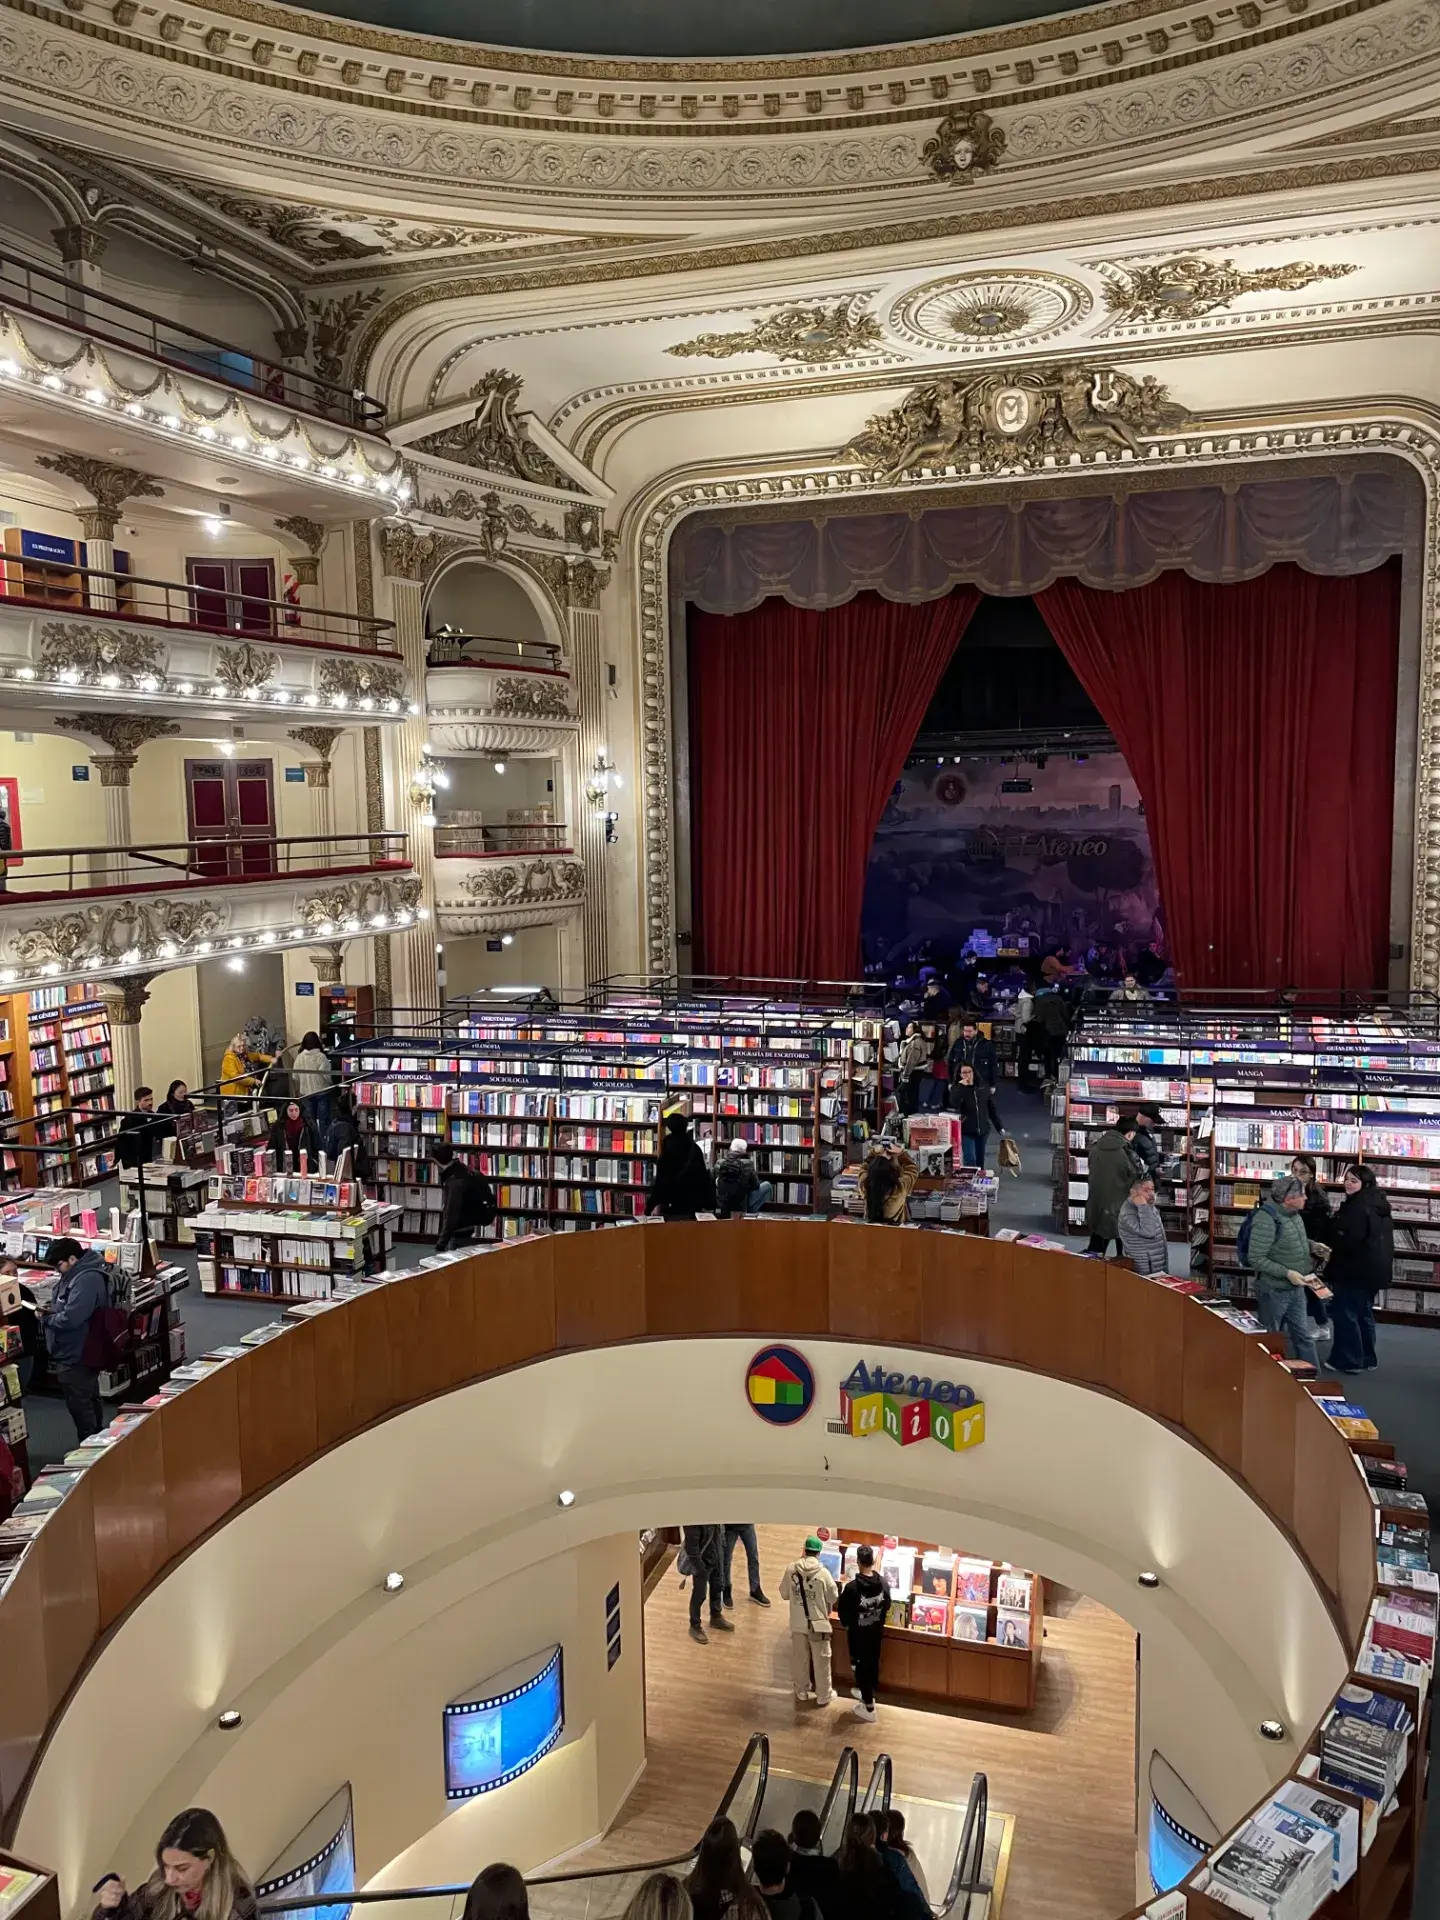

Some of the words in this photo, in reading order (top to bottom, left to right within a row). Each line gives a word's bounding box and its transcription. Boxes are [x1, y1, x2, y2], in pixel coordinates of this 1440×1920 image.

[1035, 835, 1108, 857] Ateneo
[1116, 1065, 1142, 1073] MANGA
[1365, 1074, 1393, 1082] MANGA
[1269, 1109, 1301, 1118] MANGA
[842, 1358, 976, 1407] Ateneo
